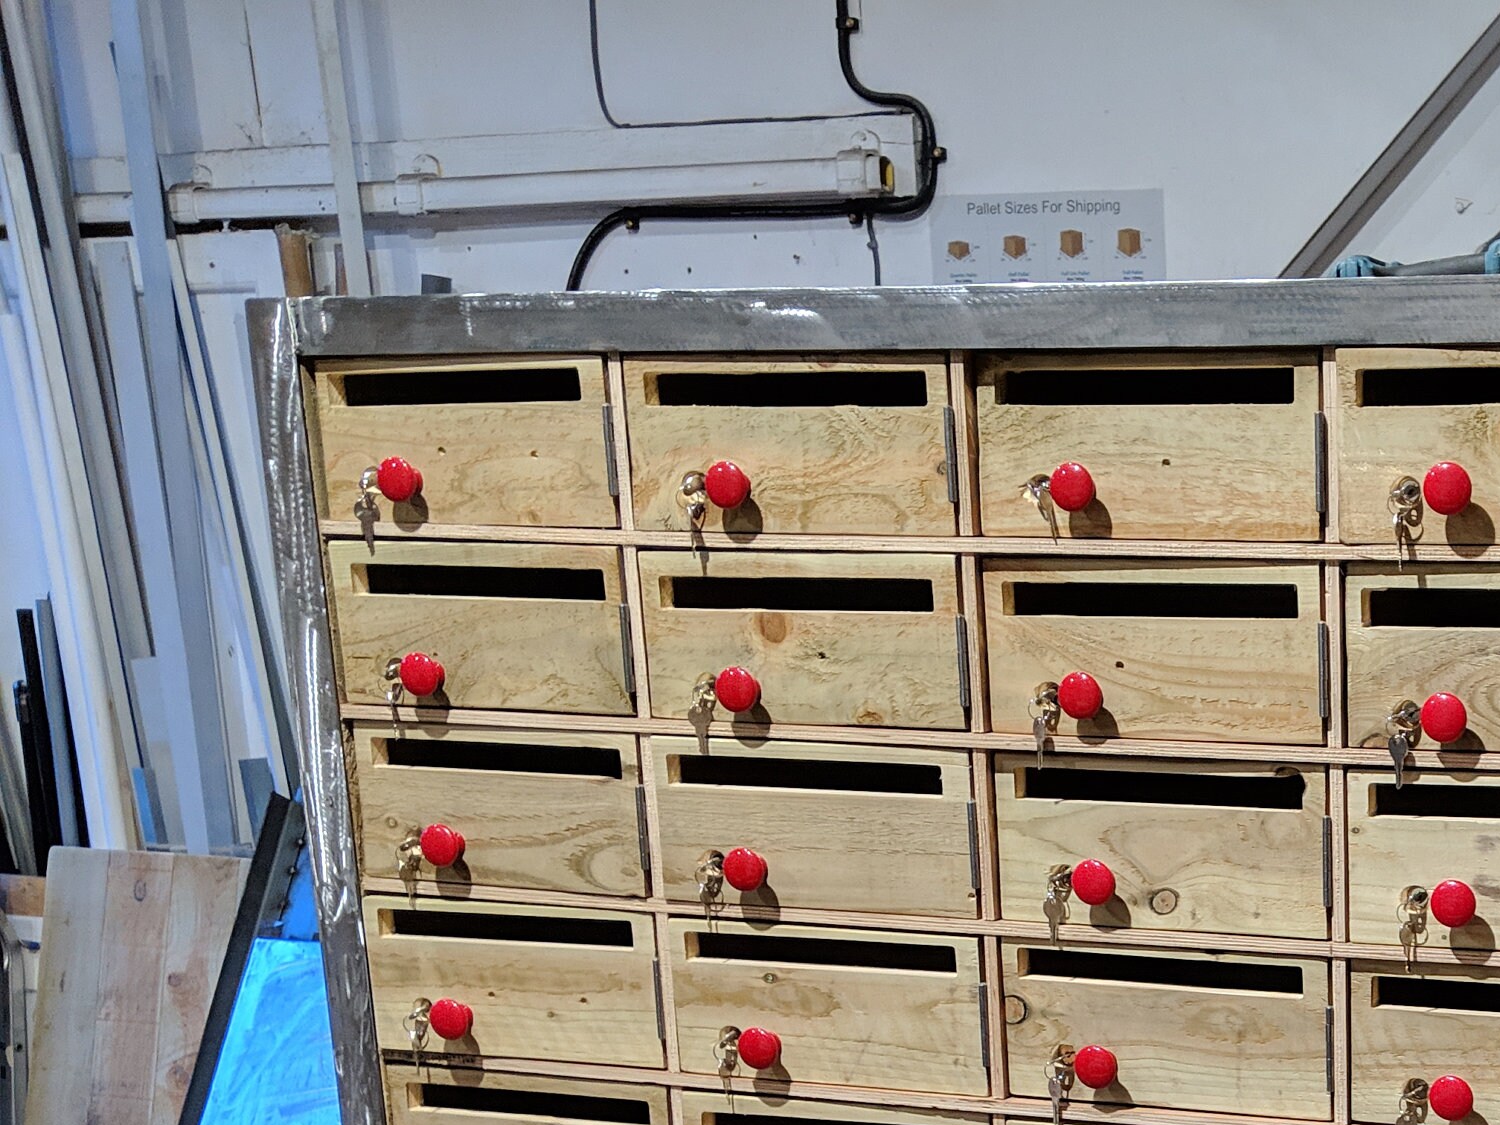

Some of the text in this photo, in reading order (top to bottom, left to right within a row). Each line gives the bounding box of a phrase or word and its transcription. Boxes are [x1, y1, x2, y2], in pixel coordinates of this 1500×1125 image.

[966, 199, 1121, 215] Pallet Sizes For Shipping
